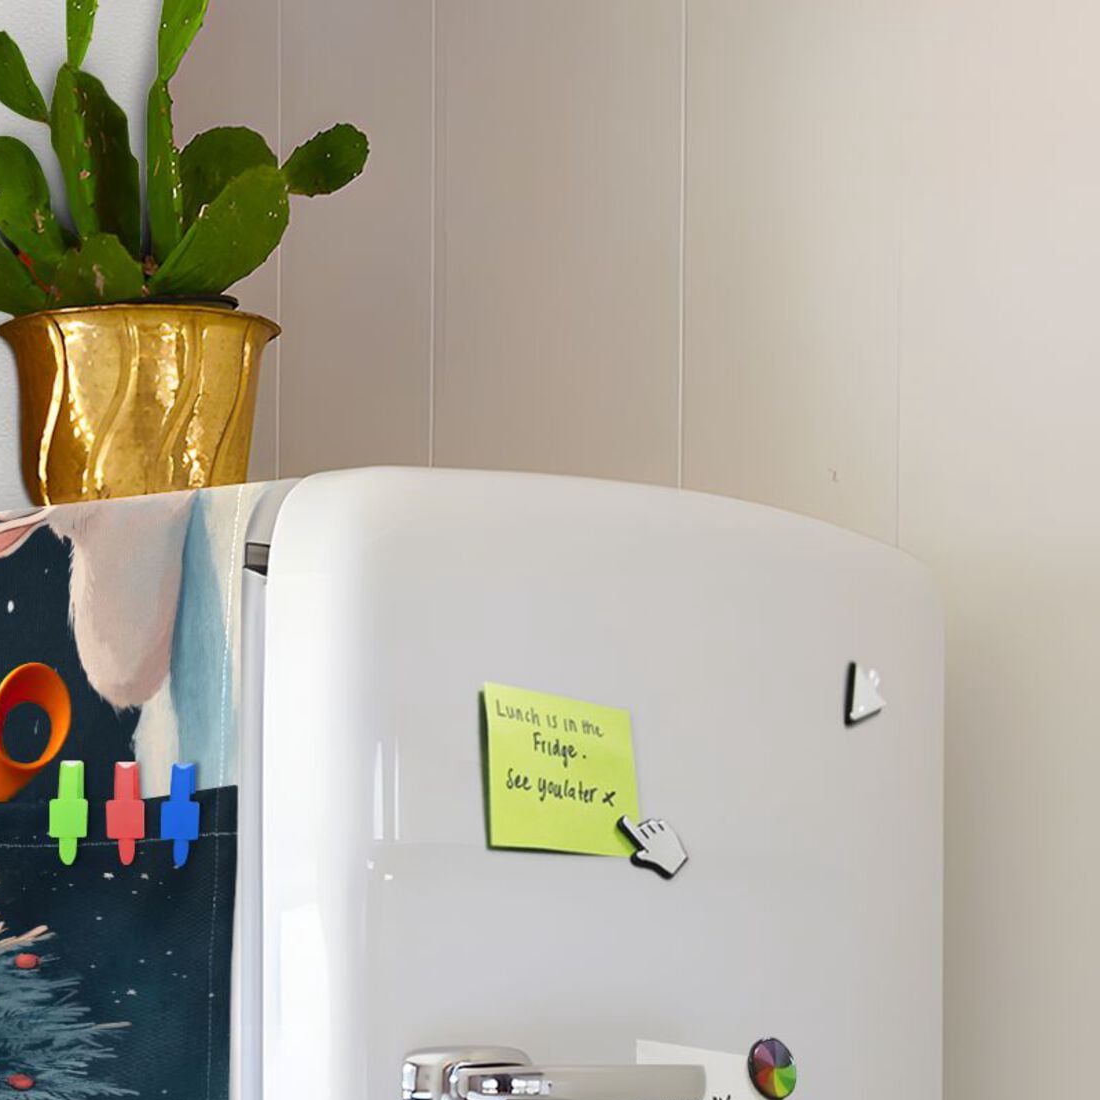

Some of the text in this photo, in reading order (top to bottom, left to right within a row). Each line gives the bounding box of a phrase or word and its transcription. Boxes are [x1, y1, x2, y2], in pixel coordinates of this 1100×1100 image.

[496, 700, 540, 727] Lunch
[582, 720, 604, 738] the
[506, 768, 532, 791] See
